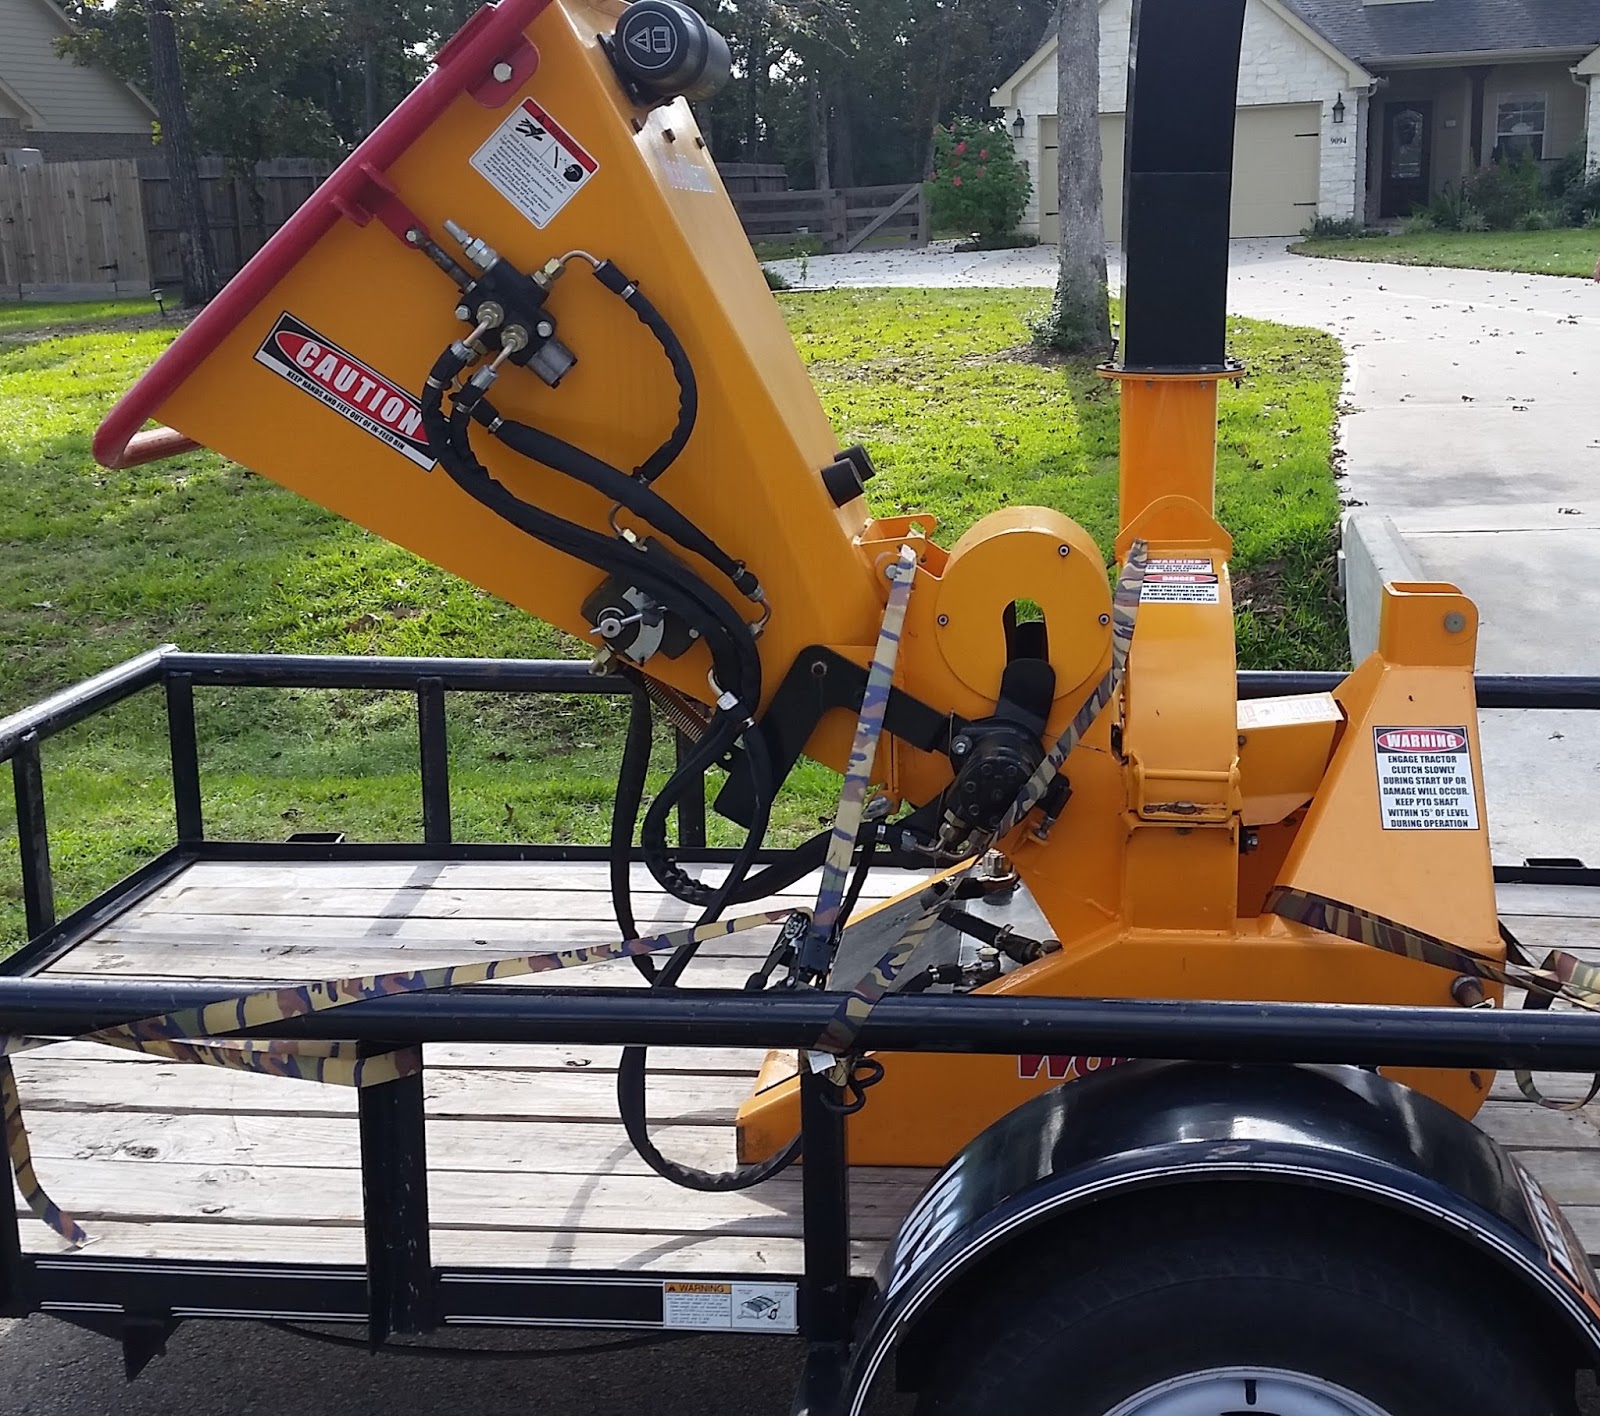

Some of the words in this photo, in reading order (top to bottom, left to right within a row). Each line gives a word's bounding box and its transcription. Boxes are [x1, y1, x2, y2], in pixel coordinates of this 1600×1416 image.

[509, 133, 519, 143] HIGH
[518, 142, 539, 163] PRESSURE
[539, 162, 551, 174] FLUID
[550, 173, 567, 190] HAZARD
[547, 124, 581, 157] WARNING
[285, 370, 302, 384] KEEP
[301, 380, 323, 398] HANDS
[322, 393, 336, 406] AND
[335, 401, 350, 415] FEET
[349, 410, 363, 423] OUT
[362, 418, 371, 428] OF
[370, 423, 394, 443] IN-FEED
[394, 438, 405, 450] BIN
[295, 341, 423, 437] CAUTION
[1386, 734, 1457, 747] WARNING
[680, 1284, 724, 1292] WARNING
